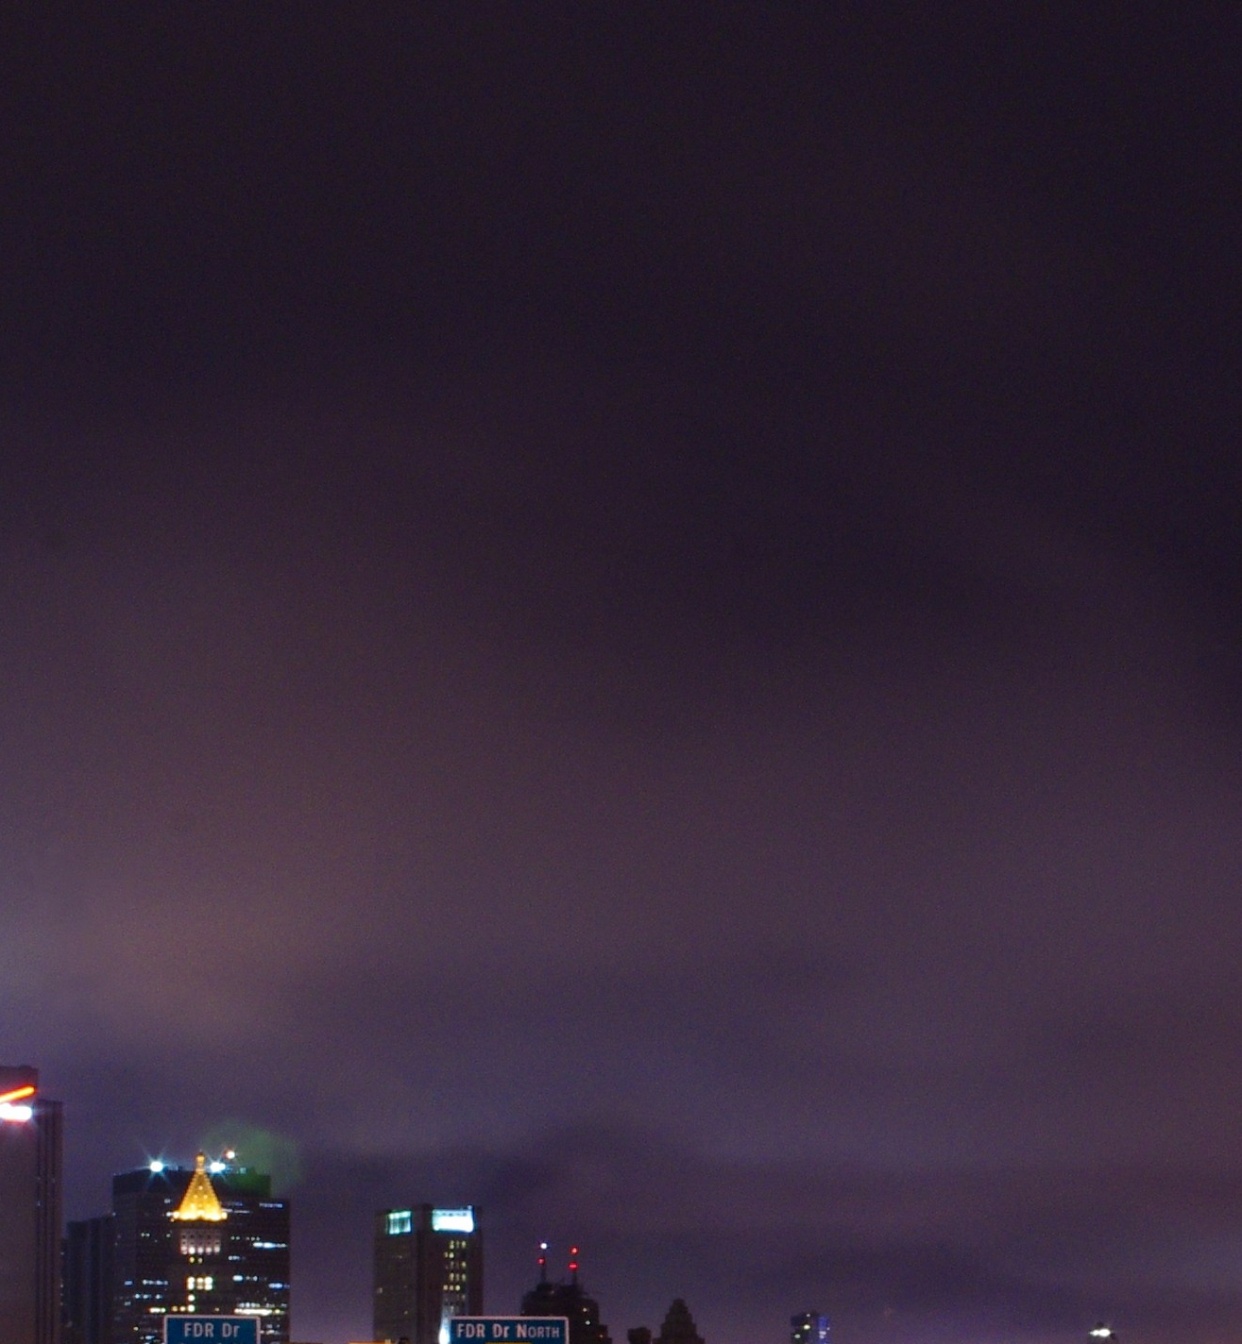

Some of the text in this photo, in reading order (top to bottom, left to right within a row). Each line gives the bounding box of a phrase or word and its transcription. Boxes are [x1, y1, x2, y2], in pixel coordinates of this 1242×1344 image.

[184, 1322, 240, 1338] FDR Dr
[456, 1323, 485, 1338] FDR
[492, 1323, 510, 1338] Dr
